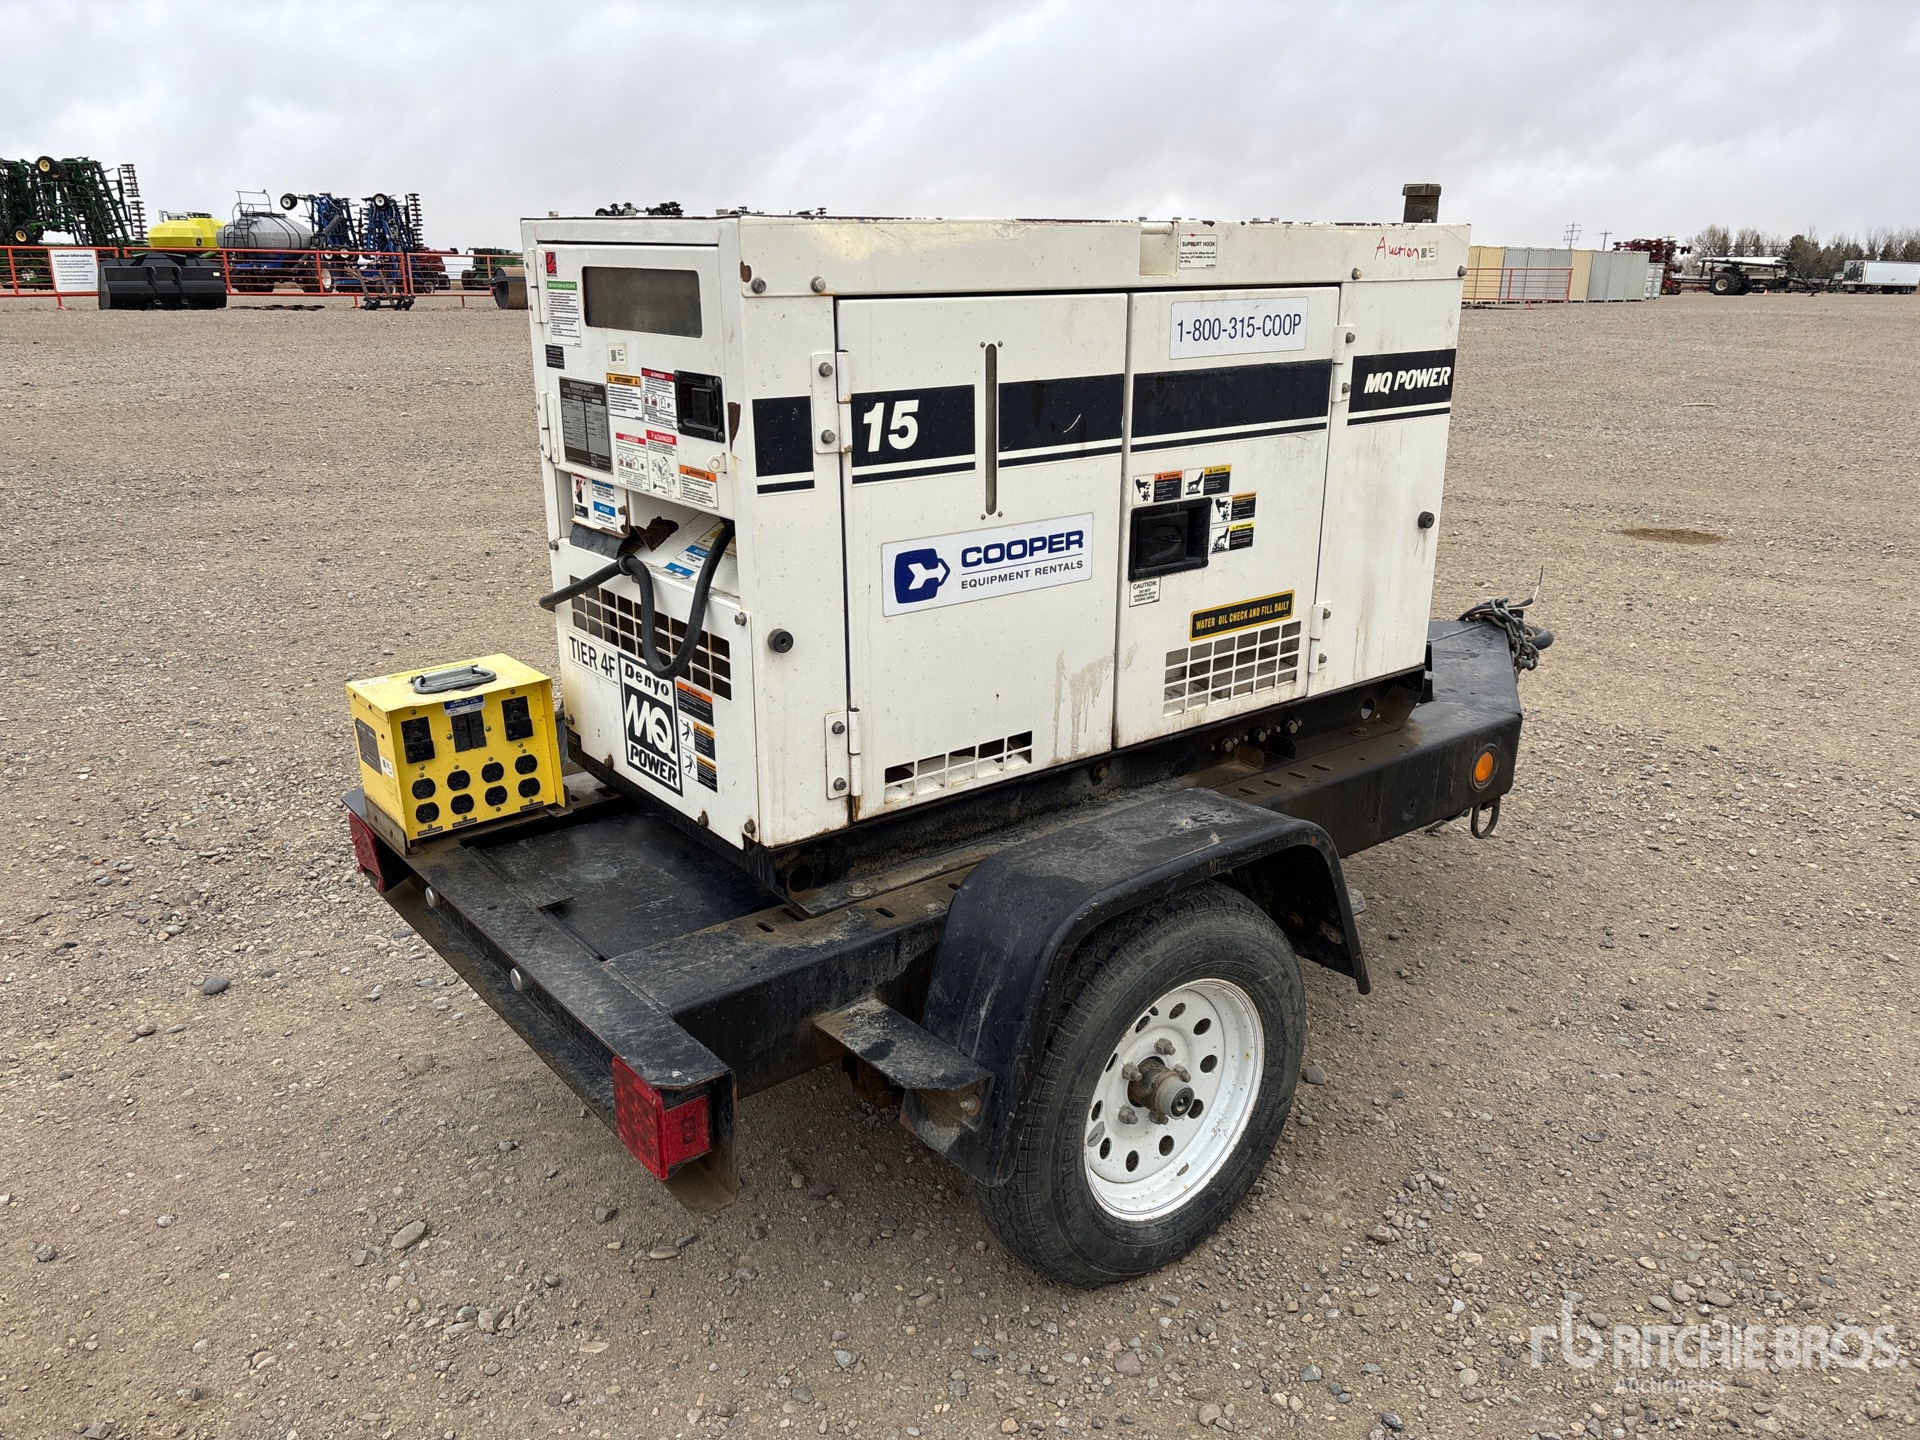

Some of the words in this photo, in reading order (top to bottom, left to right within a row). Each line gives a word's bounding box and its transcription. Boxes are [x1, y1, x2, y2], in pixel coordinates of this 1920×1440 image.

[1374, 236, 1420, 260] Auction
[1177, 313, 1302, 343] 1-800-315-COOP
[1363, 371, 1393, 395] MQ
[1393, 366, 1452, 391] POWER
[863, 399, 919, 453] 15
[961, 529, 1084, 568] COOPER
[961, 569, 1031, 589] EQUIPMENT
[1034, 560, 1084, 577] RENTALS
[1195, 617, 1216, 630] WATER
[1218, 614, 1228, 625] OIL
[1229, 609, 1248, 623] CHECK
[1248, 607, 1261, 618] AND
[1261, 604, 1273, 616] FILL
[1274, 600, 1290, 613] DAILY
[568, 636, 598, 671] TIER
[600, 653, 616, 679] 4F
[624, 663, 670, 696] Denyo
[626, 693, 677, 766] MQ
[630, 743, 677, 786] POWER
